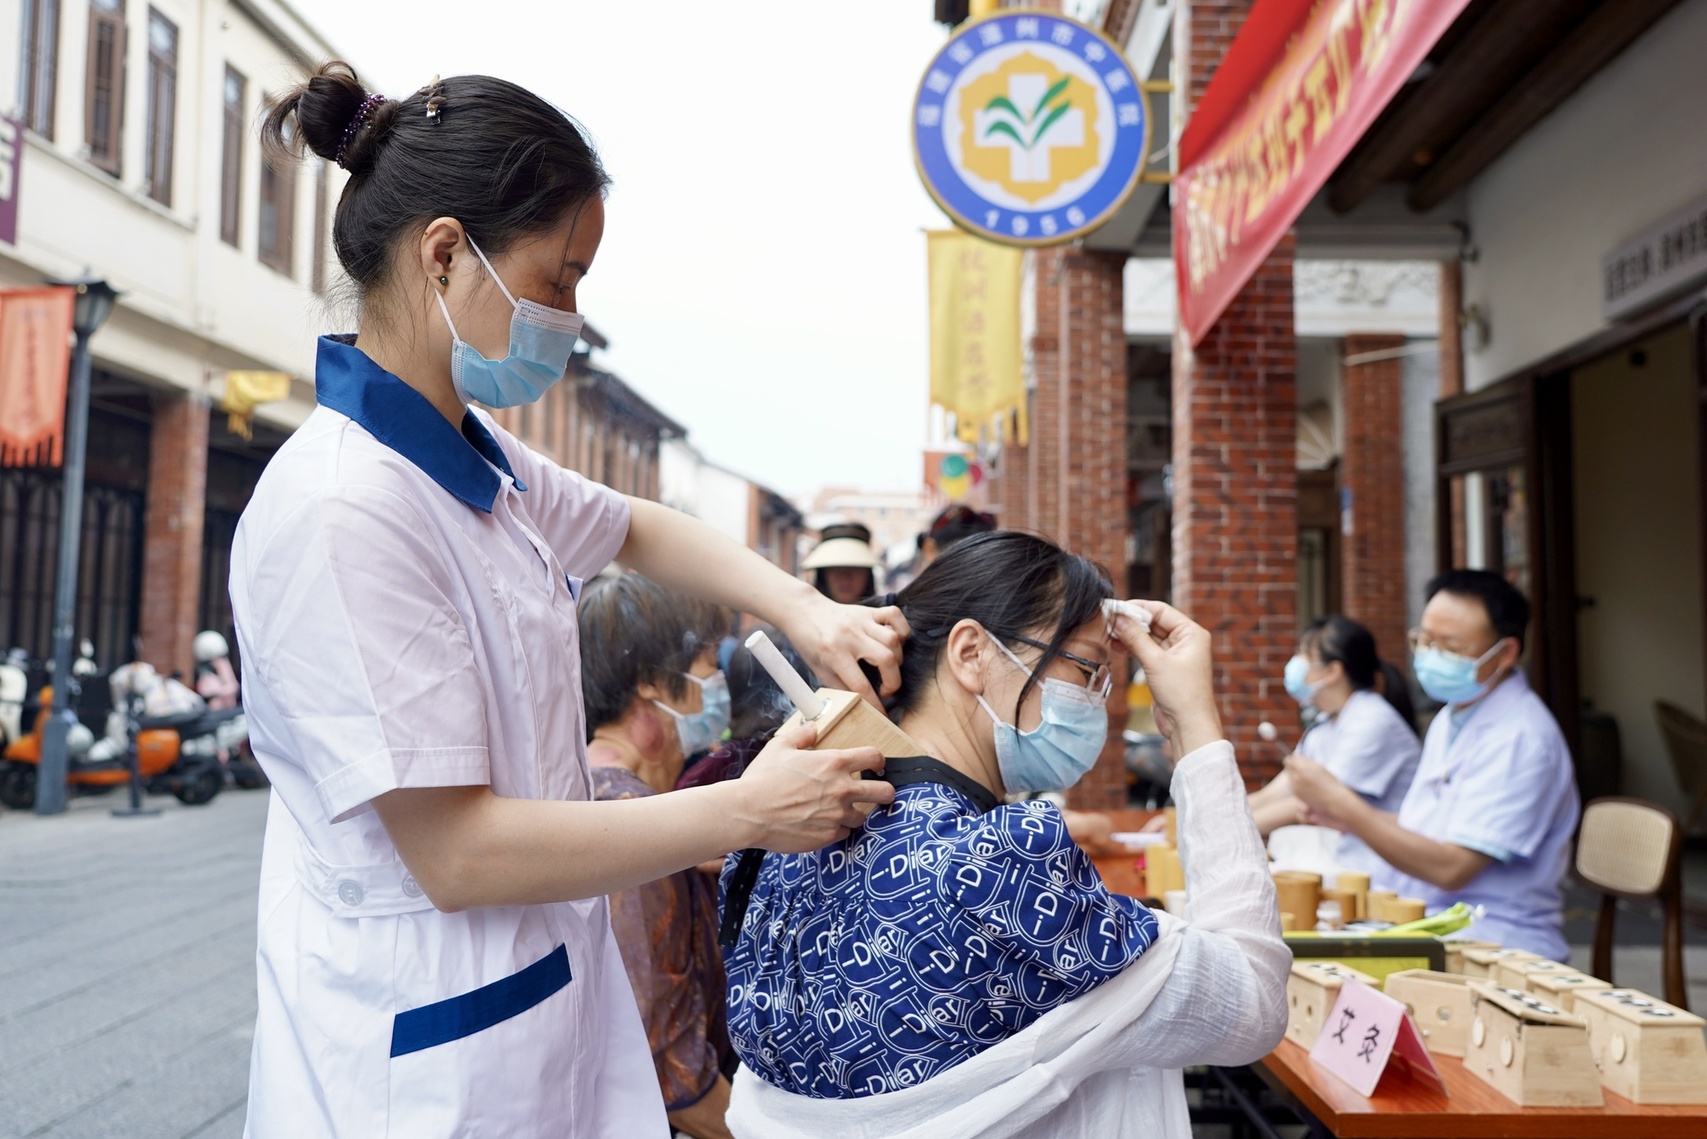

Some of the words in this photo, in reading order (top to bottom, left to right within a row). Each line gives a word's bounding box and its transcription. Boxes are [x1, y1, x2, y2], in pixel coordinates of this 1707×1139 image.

[984, 206, 1086, 237] 1956
[829, 837, 875, 874] Diar
[890, 845, 947, 879] Diar
[956, 828, 999, 888] Diar
[1033, 855, 1070, 918] Diar
[853, 929, 899, 967] Diar
[965, 909, 1006, 959] Diar
[824, 993, 873, 1034] Diar
[901, 998, 959, 1034] Diar
[1332, 1007, 1380, 1063] 艾灸
[867, 1059, 925, 1096] Diar
